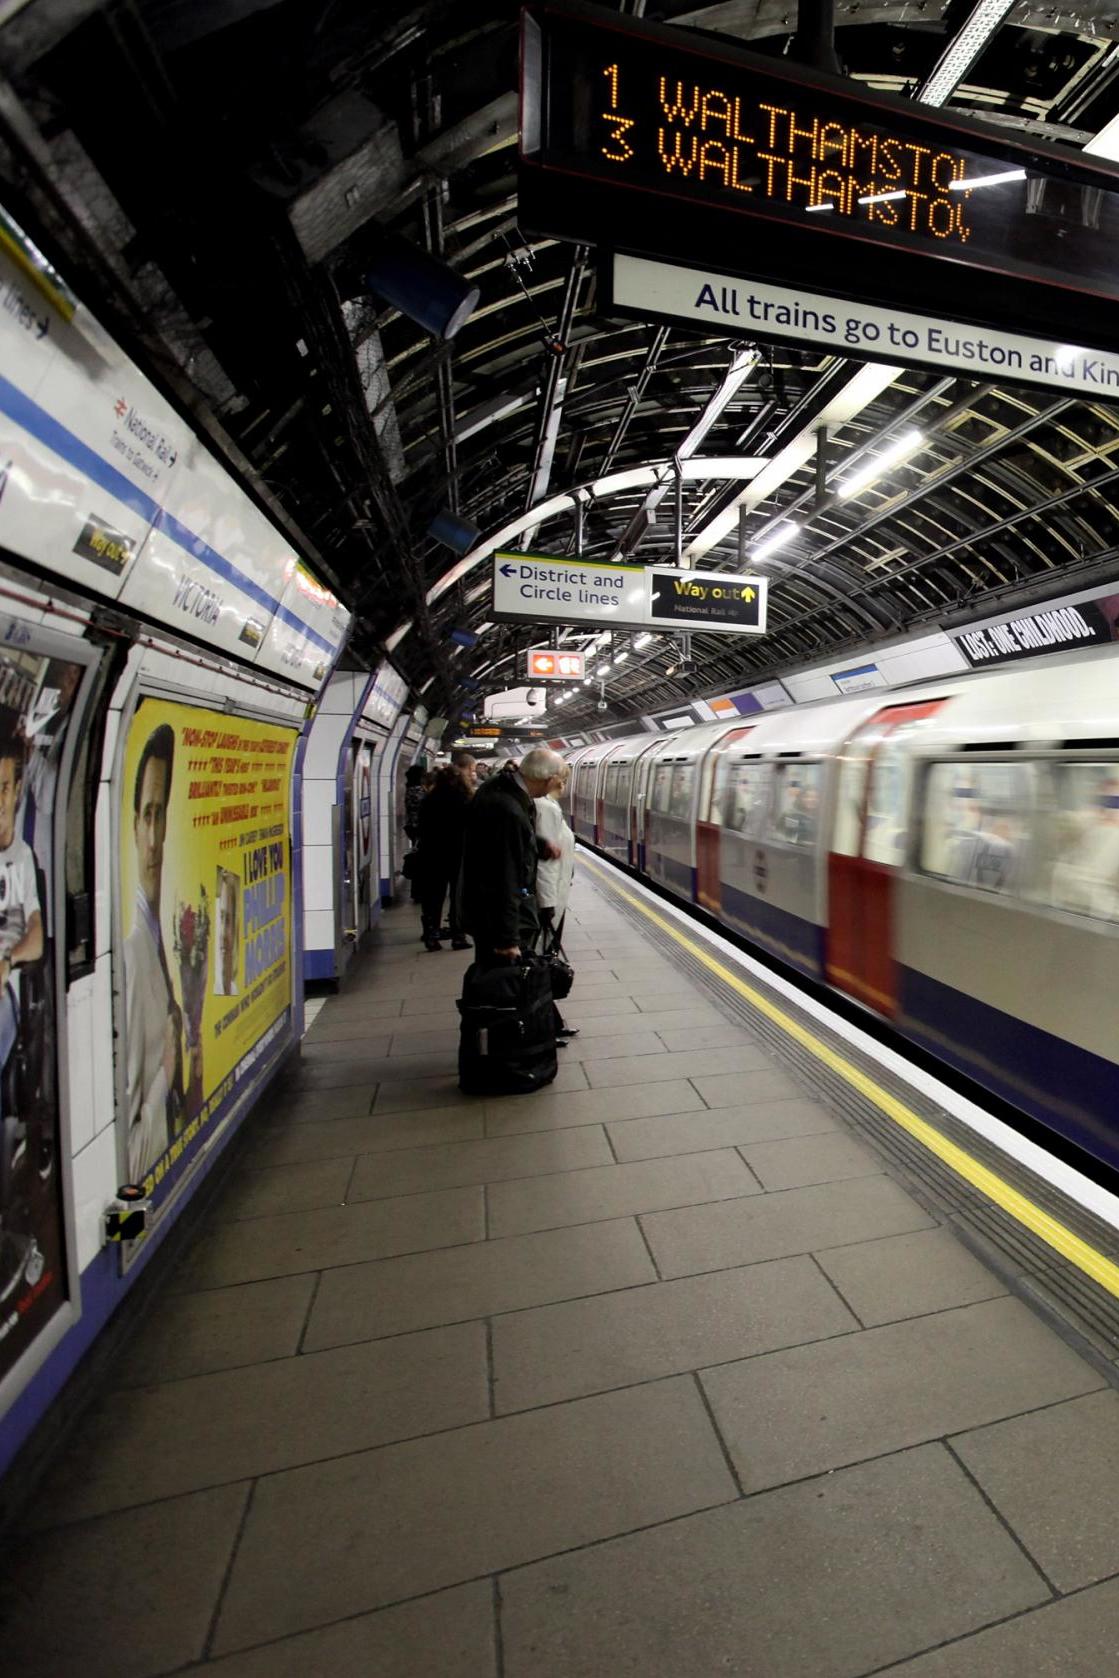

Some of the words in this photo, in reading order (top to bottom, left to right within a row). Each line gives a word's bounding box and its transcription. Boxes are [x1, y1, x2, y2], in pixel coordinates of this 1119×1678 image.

[603, 63, 618, 109] 1
[602, 113, 634, 162] 3
[694, 284, 740, 316] All
[747, 294, 836, 333] trains
[844, 318, 880, 343] go
[888, 323, 919, 348] to
[927, 328, 1022, 369] Euston
[1030, 352, 1075, 378] and
[520, 566, 587, 585] District
[593, 574, 624, 588] and
[520, 584, 571, 601] Circle
[578, 590, 619, 606] lines
[674, 581, 709, 600] Way
[712, 587, 740, 600] out
[674, 605, 708, 614] National
[960, 630, 999, 660] LOST:
[988, 624, 1021, 654] ONE
[1010, 607, 1096, 649] CHILDHOOD.
[249, 846, 267, 883] LOVE
[269, 841, 283, 873] YOU
